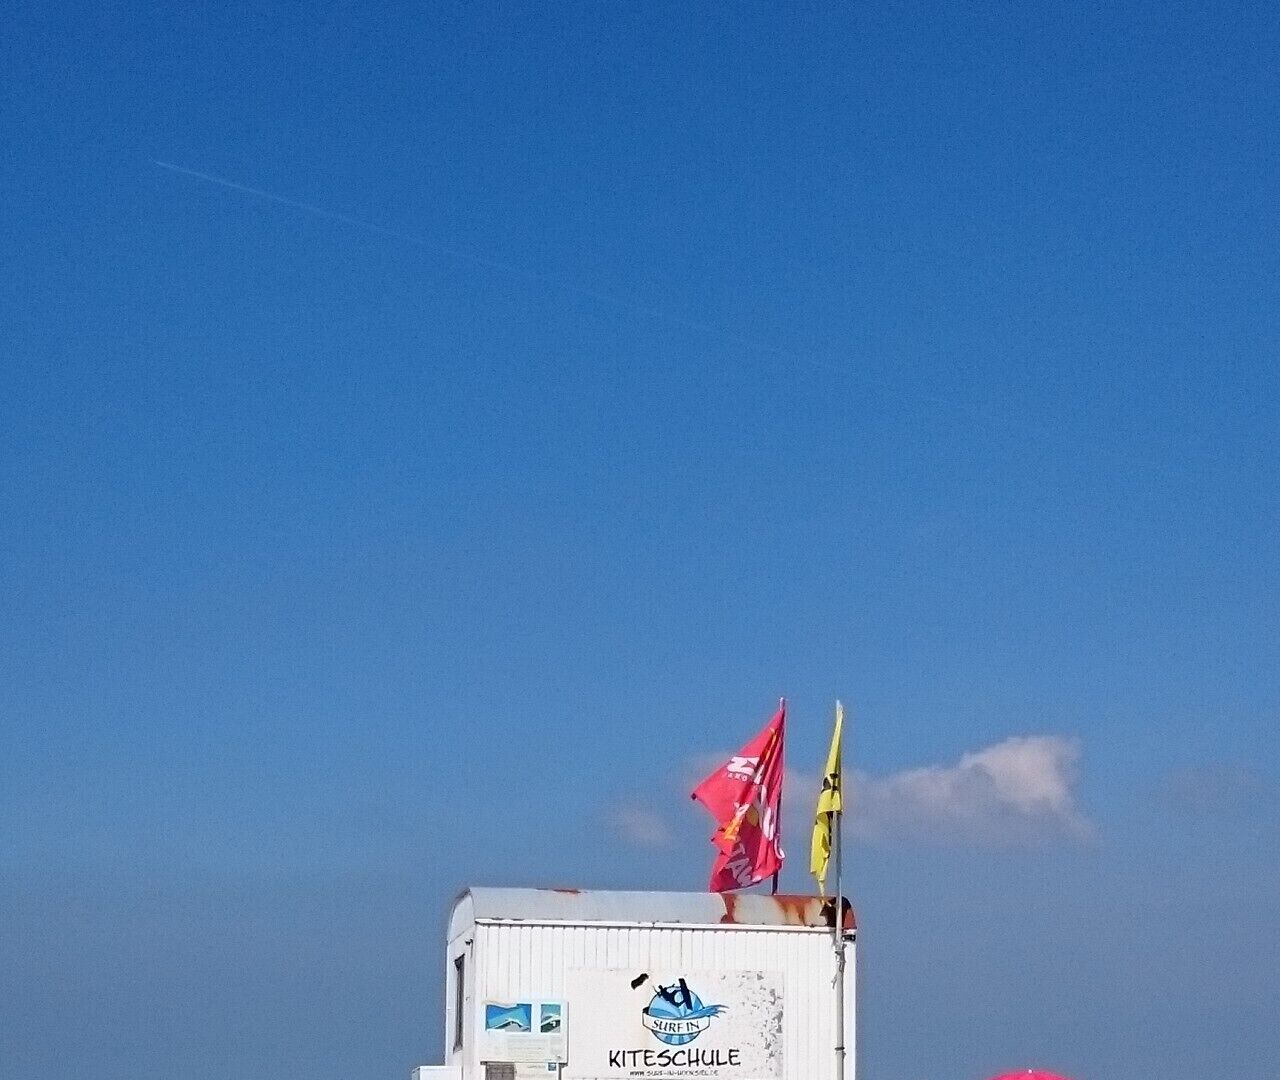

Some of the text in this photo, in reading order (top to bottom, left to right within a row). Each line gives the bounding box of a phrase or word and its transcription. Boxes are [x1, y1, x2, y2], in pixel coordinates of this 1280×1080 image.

[652, 1019, 700, 1033] SURF IN
[609, 1048, 741, 1068] KITESCHULE
